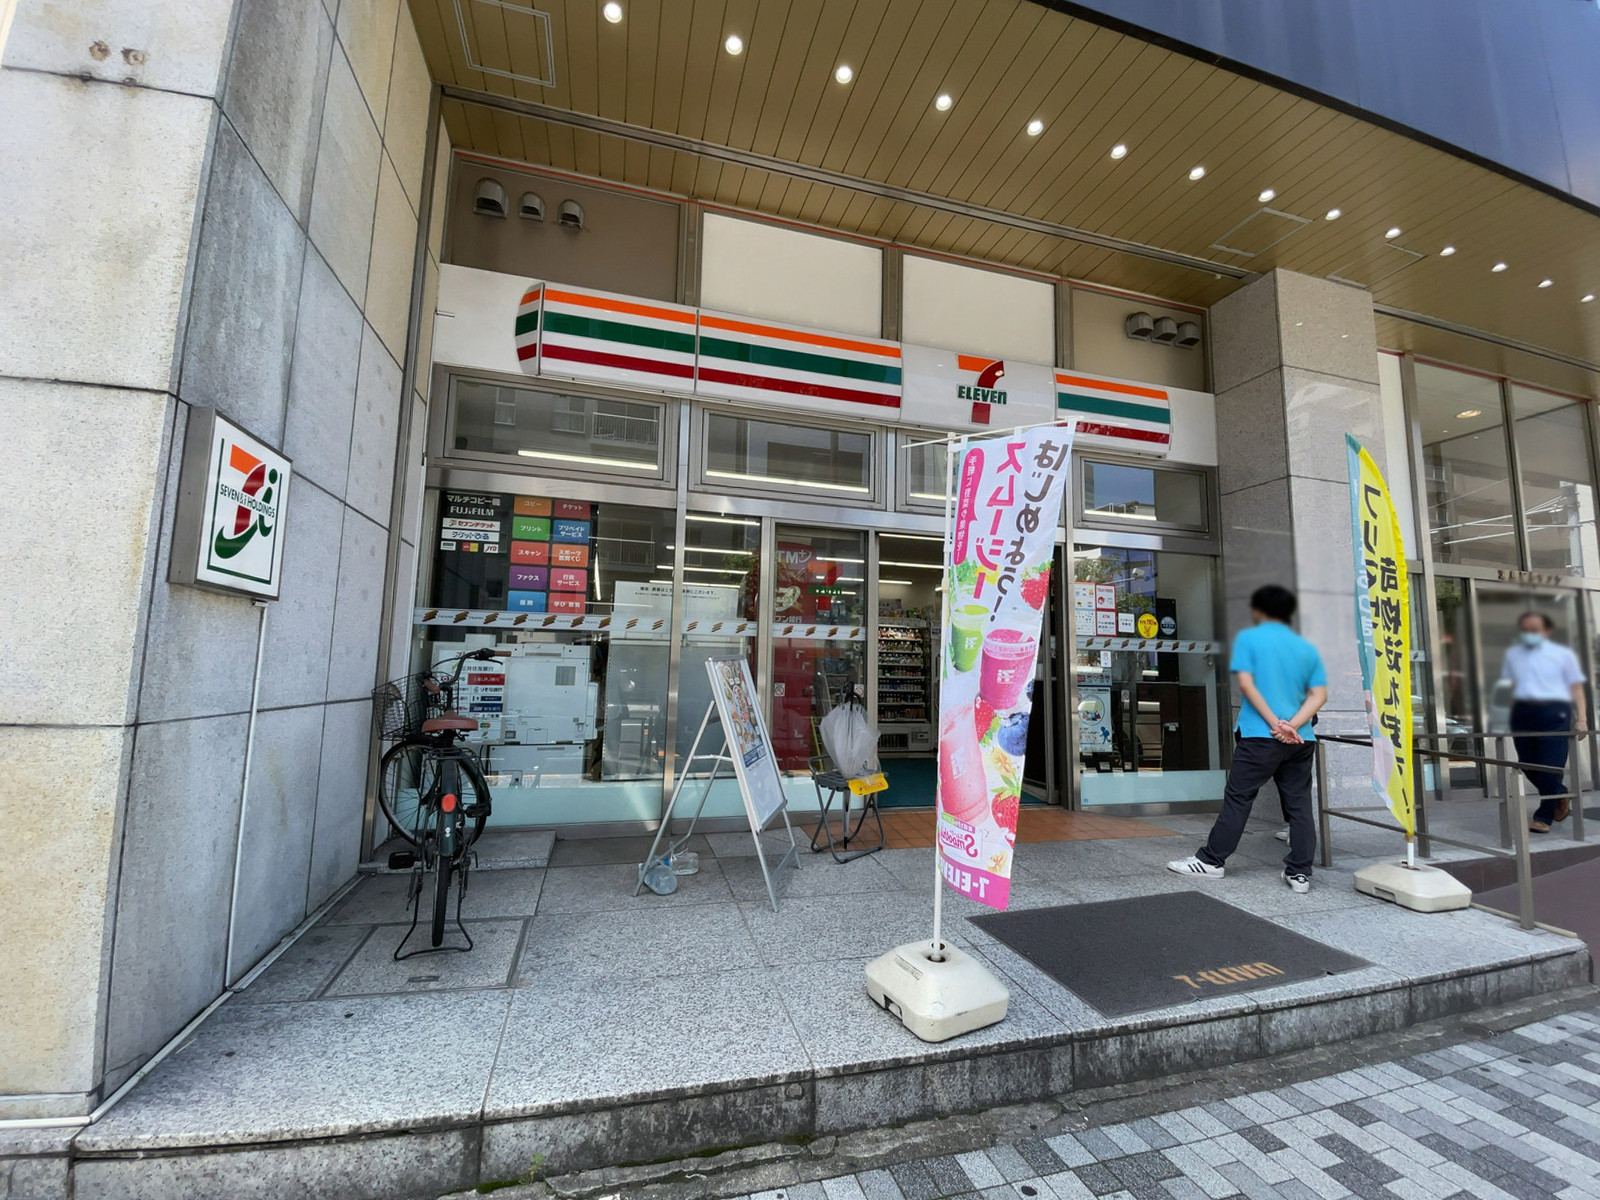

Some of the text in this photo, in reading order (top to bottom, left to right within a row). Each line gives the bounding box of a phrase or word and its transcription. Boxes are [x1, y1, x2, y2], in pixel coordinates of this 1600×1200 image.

[446, 494, 501, 506] マルチコピー機
[246, 498, 276, 519] HOLDINGS
[450, 506, 494, 516] FUJIFILM
[562, 503, 583, 511] チケット
[520, 525, 542, 533] プリント
[557, 579, 580, 587] サービス
